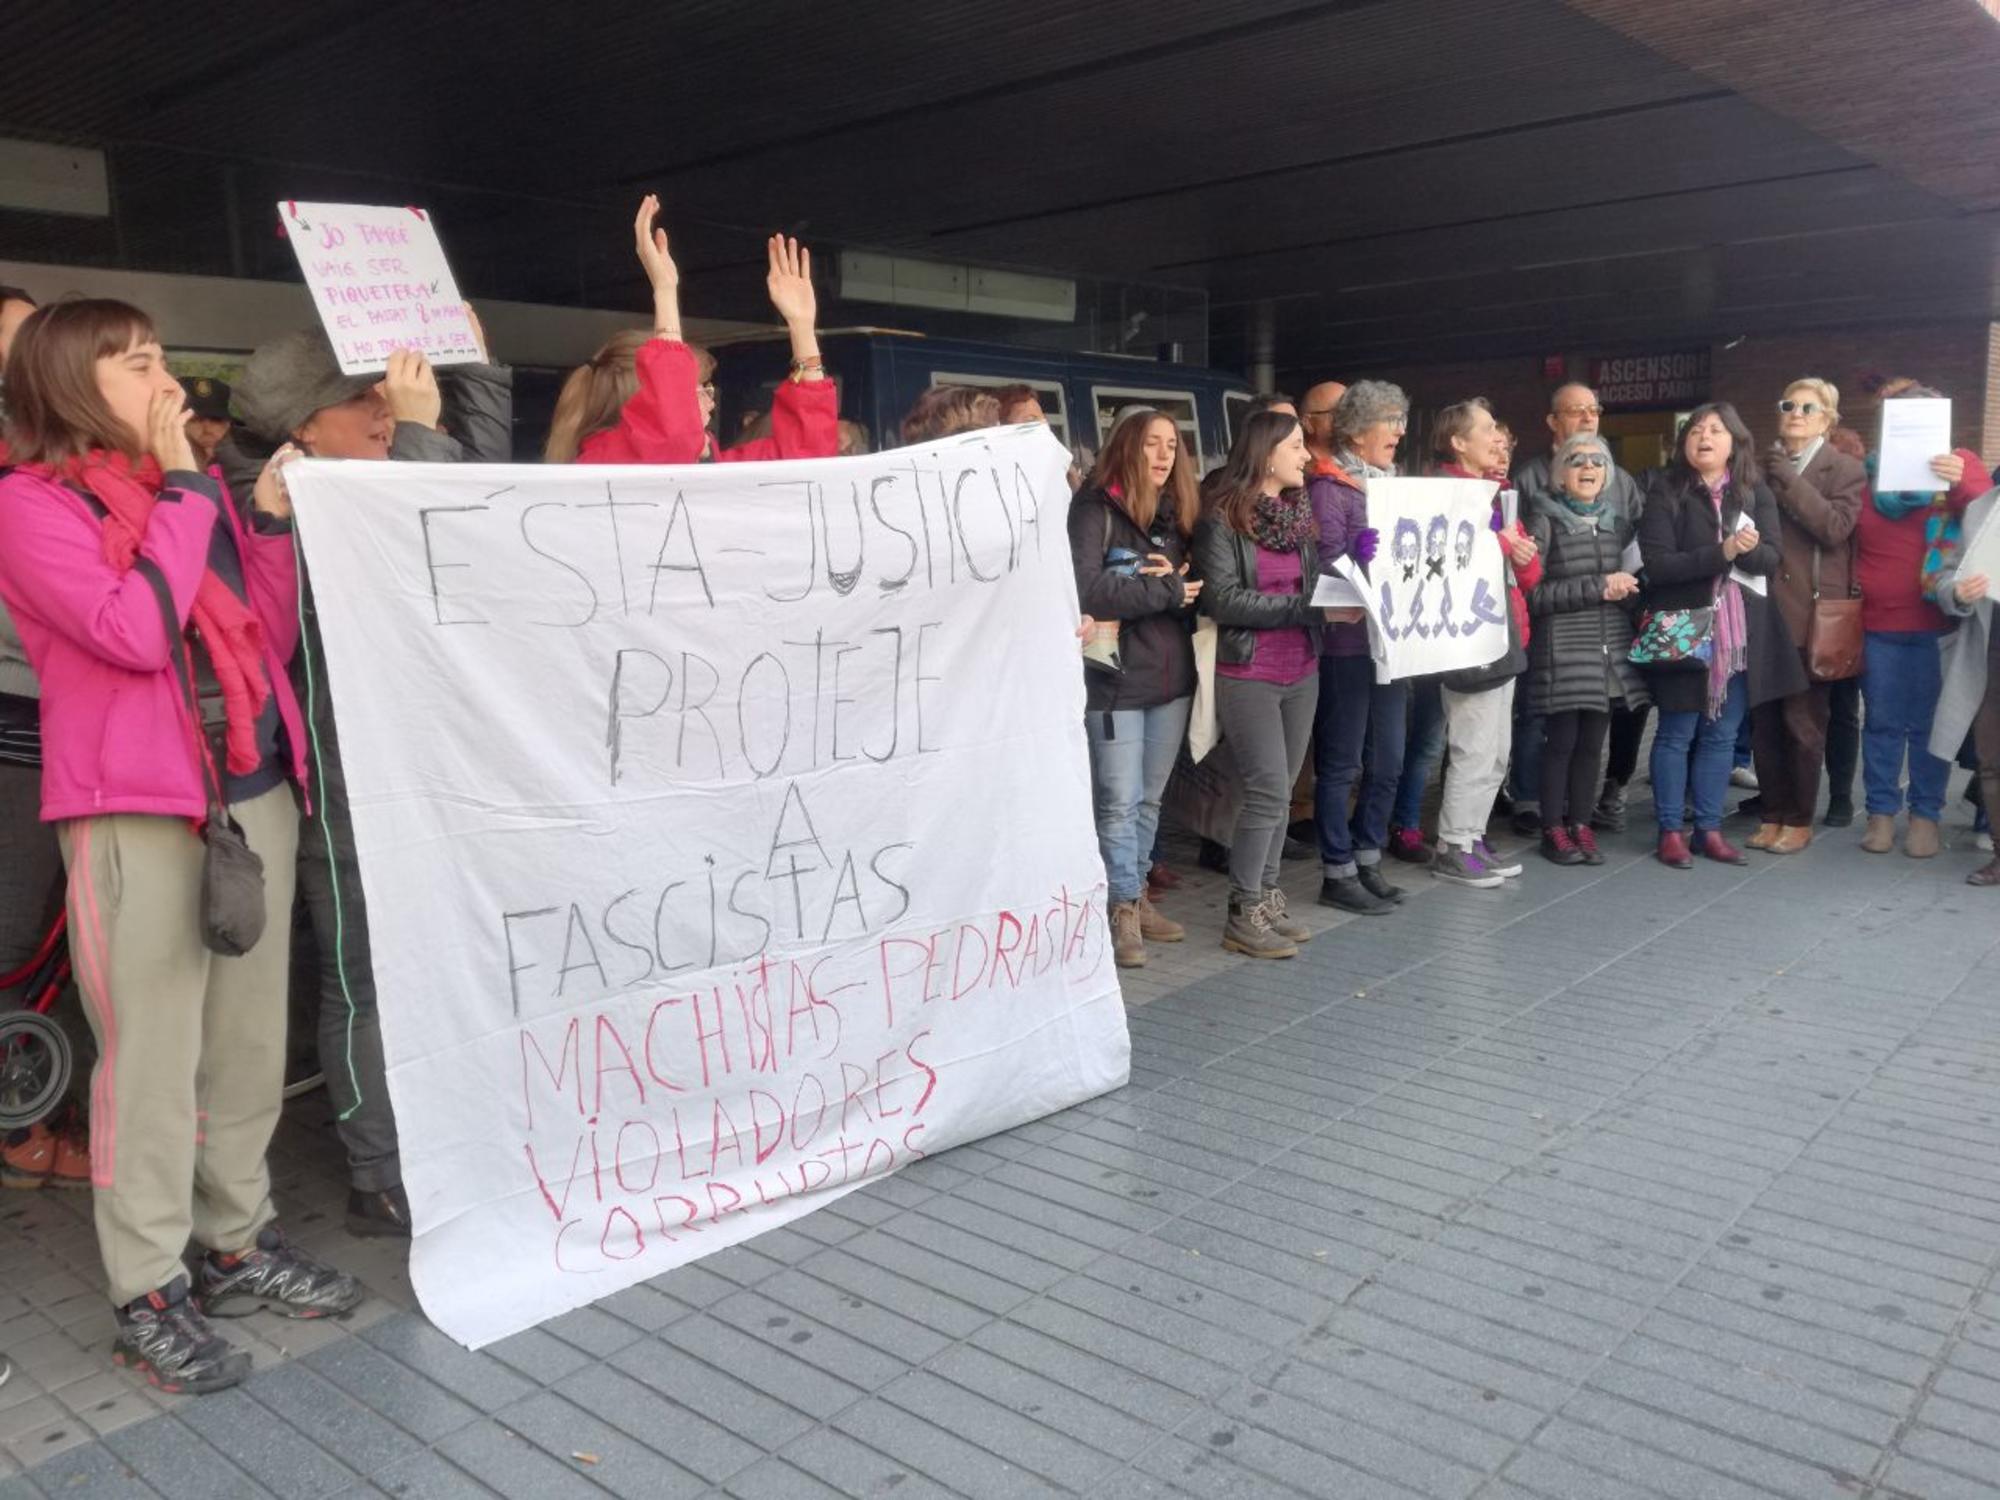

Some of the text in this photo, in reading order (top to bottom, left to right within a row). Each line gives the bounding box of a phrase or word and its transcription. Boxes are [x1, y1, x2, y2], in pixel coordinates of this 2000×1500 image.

[324, 284, 431, 305] PIQUETERA
[366, 257, 409, 276] SER
[608, 621, 945, 788] PROTEJE
[763, 780, 834, 882] A
[502, 841, 915, 1017] FASCISTAS
[524, 1030, 938, 1223] VIOLADORES
